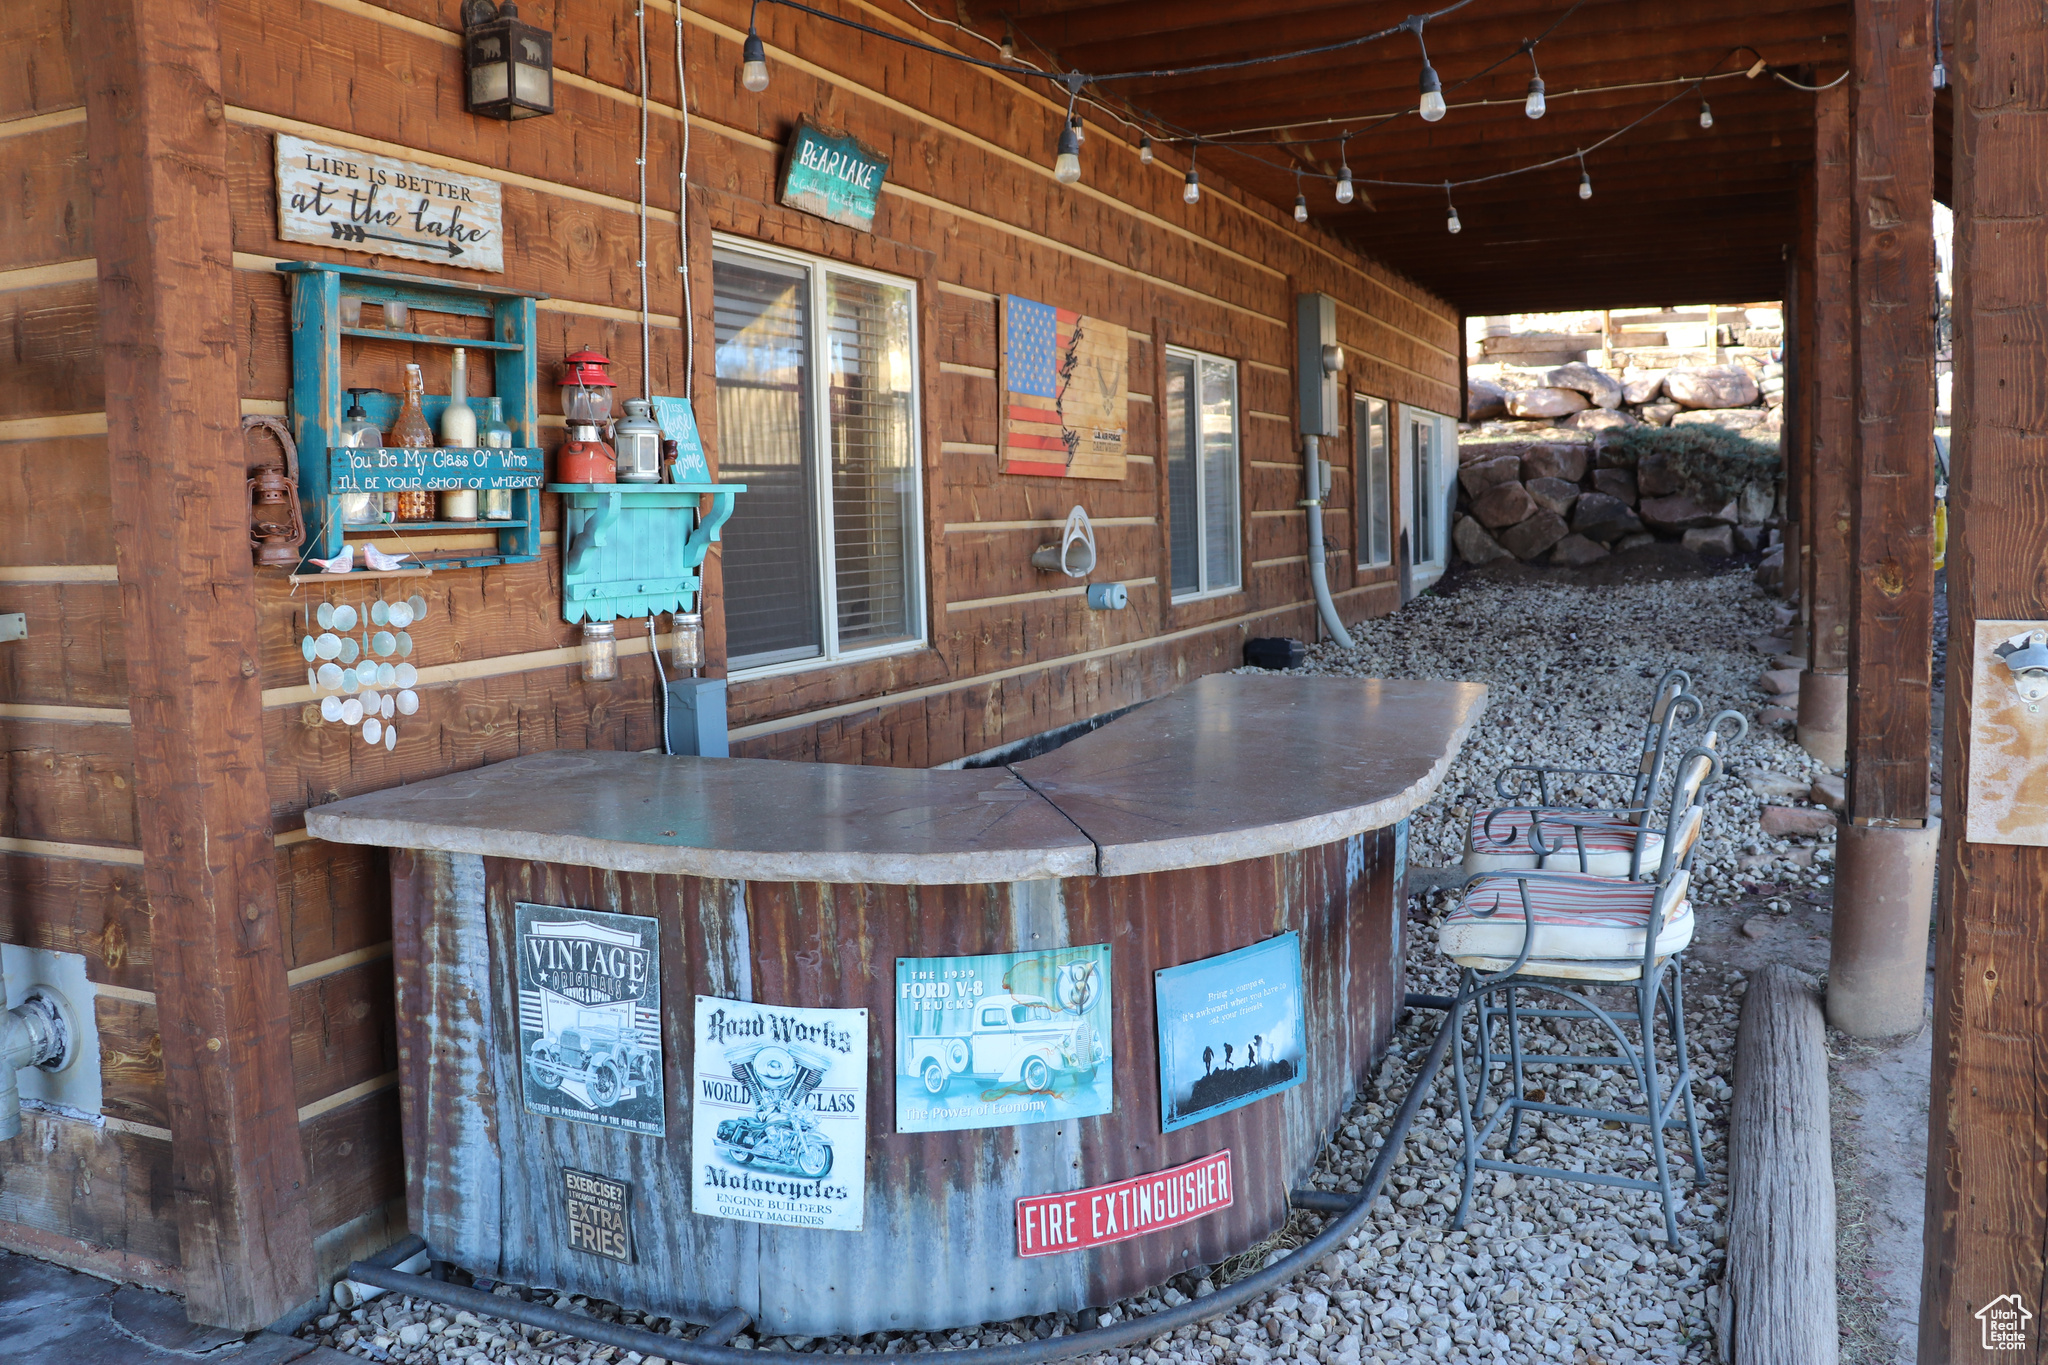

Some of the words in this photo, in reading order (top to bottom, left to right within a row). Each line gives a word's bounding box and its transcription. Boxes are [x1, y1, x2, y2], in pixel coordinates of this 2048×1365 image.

[306, 154, 359, 180] LIFE
[368, 167, 387, 185] IS
[395, 173, 474, 203] BETTER
[800, 140, 840, 176] BEAR
[838, 155, 876, 190] LAKE
[291, 182, 338, 216] at
[347, 183, 402, 227] the
[408, 198, 490, 243] lake
[660, 400, 692, 440] house
[668, 404, 684, 413] LESS
[682, 442, 698, 452] MORE
[1108, 433, 1121, 442] FORCE
[346, 450, 372, 468] You
[378, 449, 398, 468] Be
[404, 450, 428, 476] My
[433, 449, 470, 468] Glass
[473, 449, 492, 468] Of
[500, 450, 528, 468] Wine
[676, 453, 704, 480] home
[365, 476, 380, 489] BE
[384, 476, 422, 489] YOUR
[427, 476, 464, 489] SHOT
[468, 476, 486, 489] OF
[491, 476, 541, 488] WHISKEY
[530, 938, 645, 984] VINTAGE
[552, 970, 622, 1000] ORIGINALS
[911, 970, 936, 980] THE
[944, 970, 976, 980] 1939
[562, 987, 585, 1002] SERVICE
[590, 988, 611, 1003] REPAIR
[901, 980, 950, 1000] FORD
[956, 980, 984, 998] V-8
[1196, 1001, 1228, 1019] awkward
[1230, 996, 1248, 1008] when
[1250, 992, 1262, 1004] you
[1263, 986, 1278, 997] have
[1208, 990, 1228, 1002] Bring
[1229, 988, 1234, 996] a
[913, 999, 975, 1012] TRUCKS
[1221, 1010, 1238, 1024] your
[708, 1008, 764, 1044] Road
[768, 1012, 852, 1054] Works
[702, 1079, 751, 1105] WORLD
[804, 1092, 856, 1113] CLASS
[528, 1101, 551, 1113] FOCUSED
[552, 1106, 560, 1115] ON
[562, 1108, 599, 1122] PRESERVATION
[600, 1114, 608, 1123] OF
[610, 1116, 620, 1126] THE
[621, 1118, 637, 1128] FINER
[906, 1107, 929, 1122] The
[932, 1103, 972, 1120] Power
[976, 1101, 989, 1116] of
[992, 1098, 1049, 1116] Economy
[566, 1173, 622, 1202] EXERCISE?
[704, 1165, 849, 1200] Motorcycles
[572, 1190, 596, 1204] THOUGHT
[597, 1197, 609, 1208] YOU
[610, 1201, 622, 1212] SAID
[716, 1192, 764, 1208] ENGINE
[768, 1200, 832, 1214] BUILDERS
[1025, 1200, 1078, 1249] FIRE
[1092, 1160, 1228, 1238] EXTINGUISHER
[568, 1198, 625, 1234] EXTRA
[719, 1205, 764, 1220] QUALITY
[766, 1212, 824, 1226] MACHINES
[570, 1219, 626, 1260] FRIES
